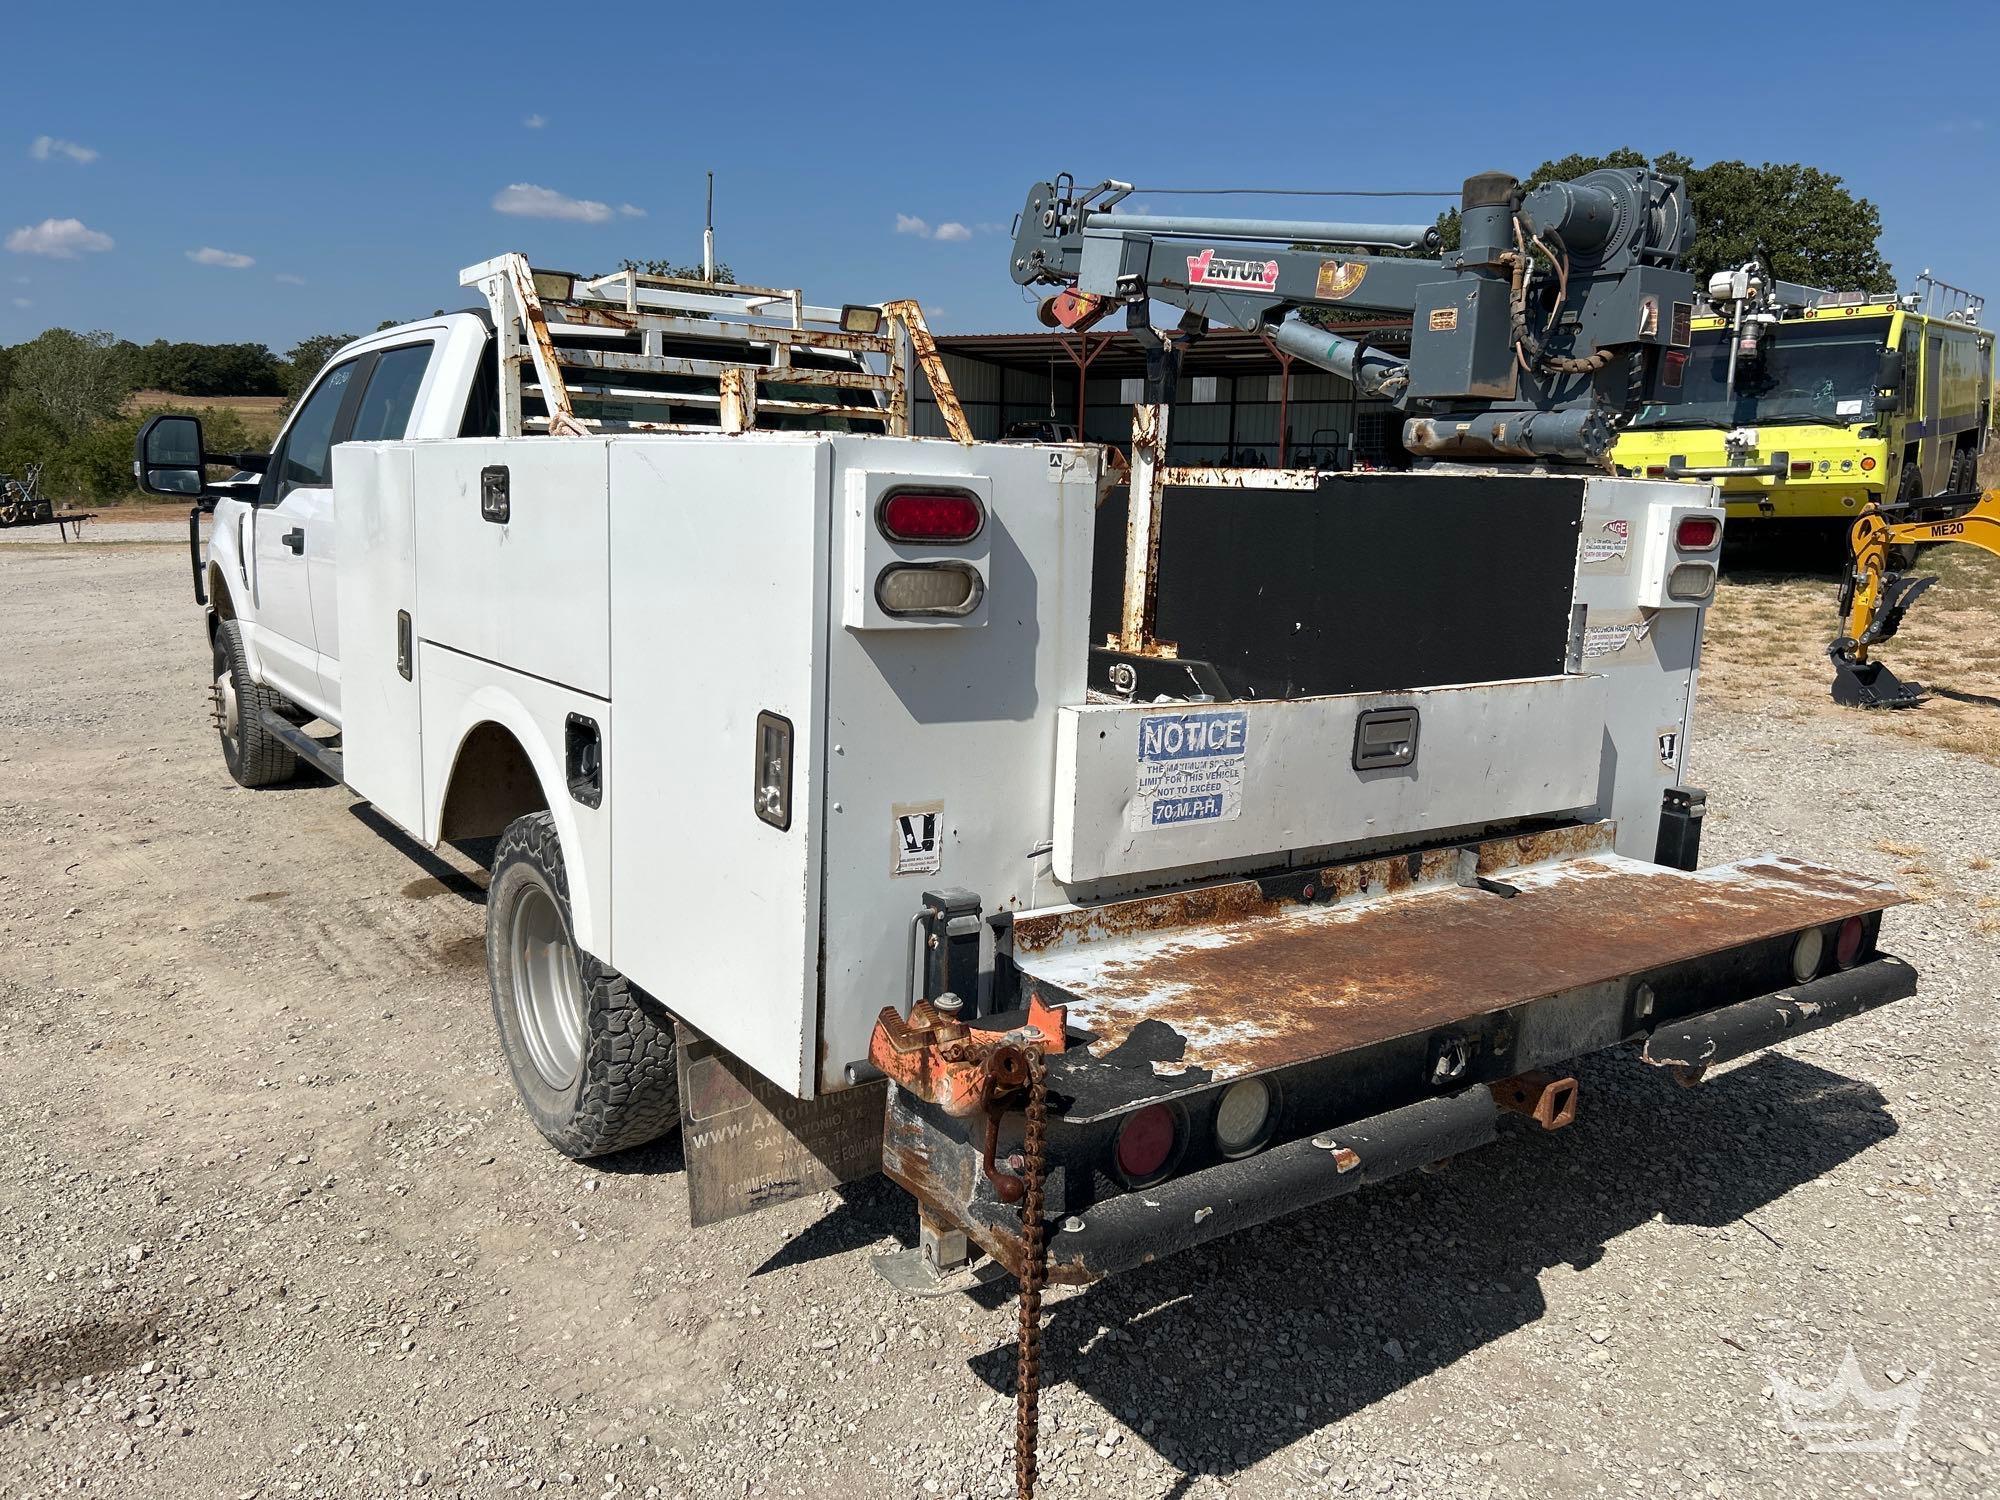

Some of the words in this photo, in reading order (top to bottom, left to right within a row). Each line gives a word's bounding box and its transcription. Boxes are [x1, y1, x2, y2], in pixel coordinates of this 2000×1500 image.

[1187, 249, 1279, 285] VENTURO
[1931, 523, 1964, 537] ME20
[1144, 719, 1243, 755] NOTICE
[1147, 764, 1164, 774] THE
[1209, 758, 1235, 770] SPED
[1139, 776, 1162, 787] LIMIT
[1165, 774, 1182, 785] FOR
[1184, 772, 1203, 782] THIS
[1205, 769, 1240, 780] VEHICLE
[1157, 788, 1175, 797] NOT
[1178, 786, 1188, 794] TO
[1190, 783, 1222, 793] EXCEED
[1156, 804, 1173, 819] 70
[754, 1136, 782, 1151] SAN
[848, 1106, 864, 1120] TX
[833, 1128, 850, 1143] TX
[728, 1167, 796, 1198] COMMERCIAL
[799, 1151, 840, 1179] VEHICLE
[842, 1134, 883, 1160] EQUIPME
